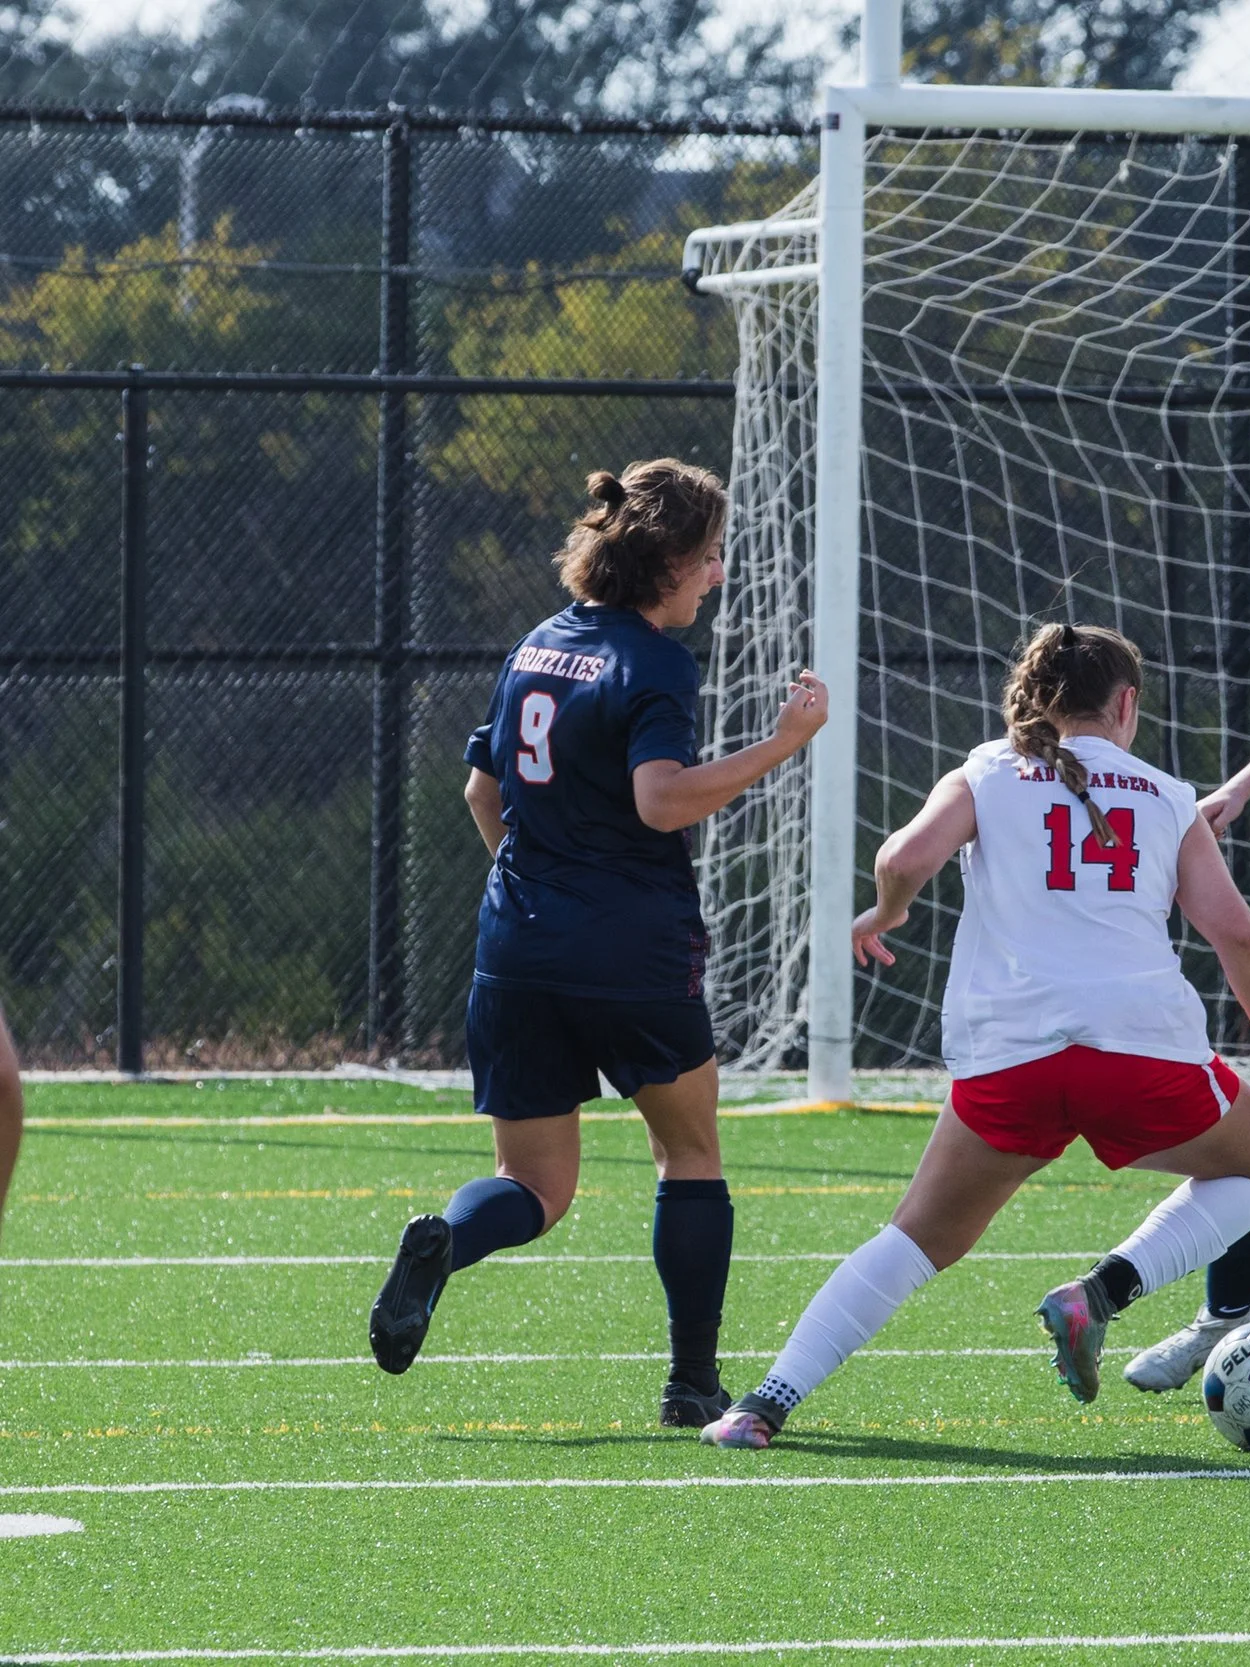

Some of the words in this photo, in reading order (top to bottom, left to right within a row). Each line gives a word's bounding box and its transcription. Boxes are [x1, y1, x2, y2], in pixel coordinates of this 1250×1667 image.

[512, 645, 605, 683] GRIZZLIES
[516, 691, 557, 784] 9
[1018, 766, 1066, 783] LAD
[1087, 772, 1160, 797] ANGERS
[1043, 803, 1141, 892] 14
